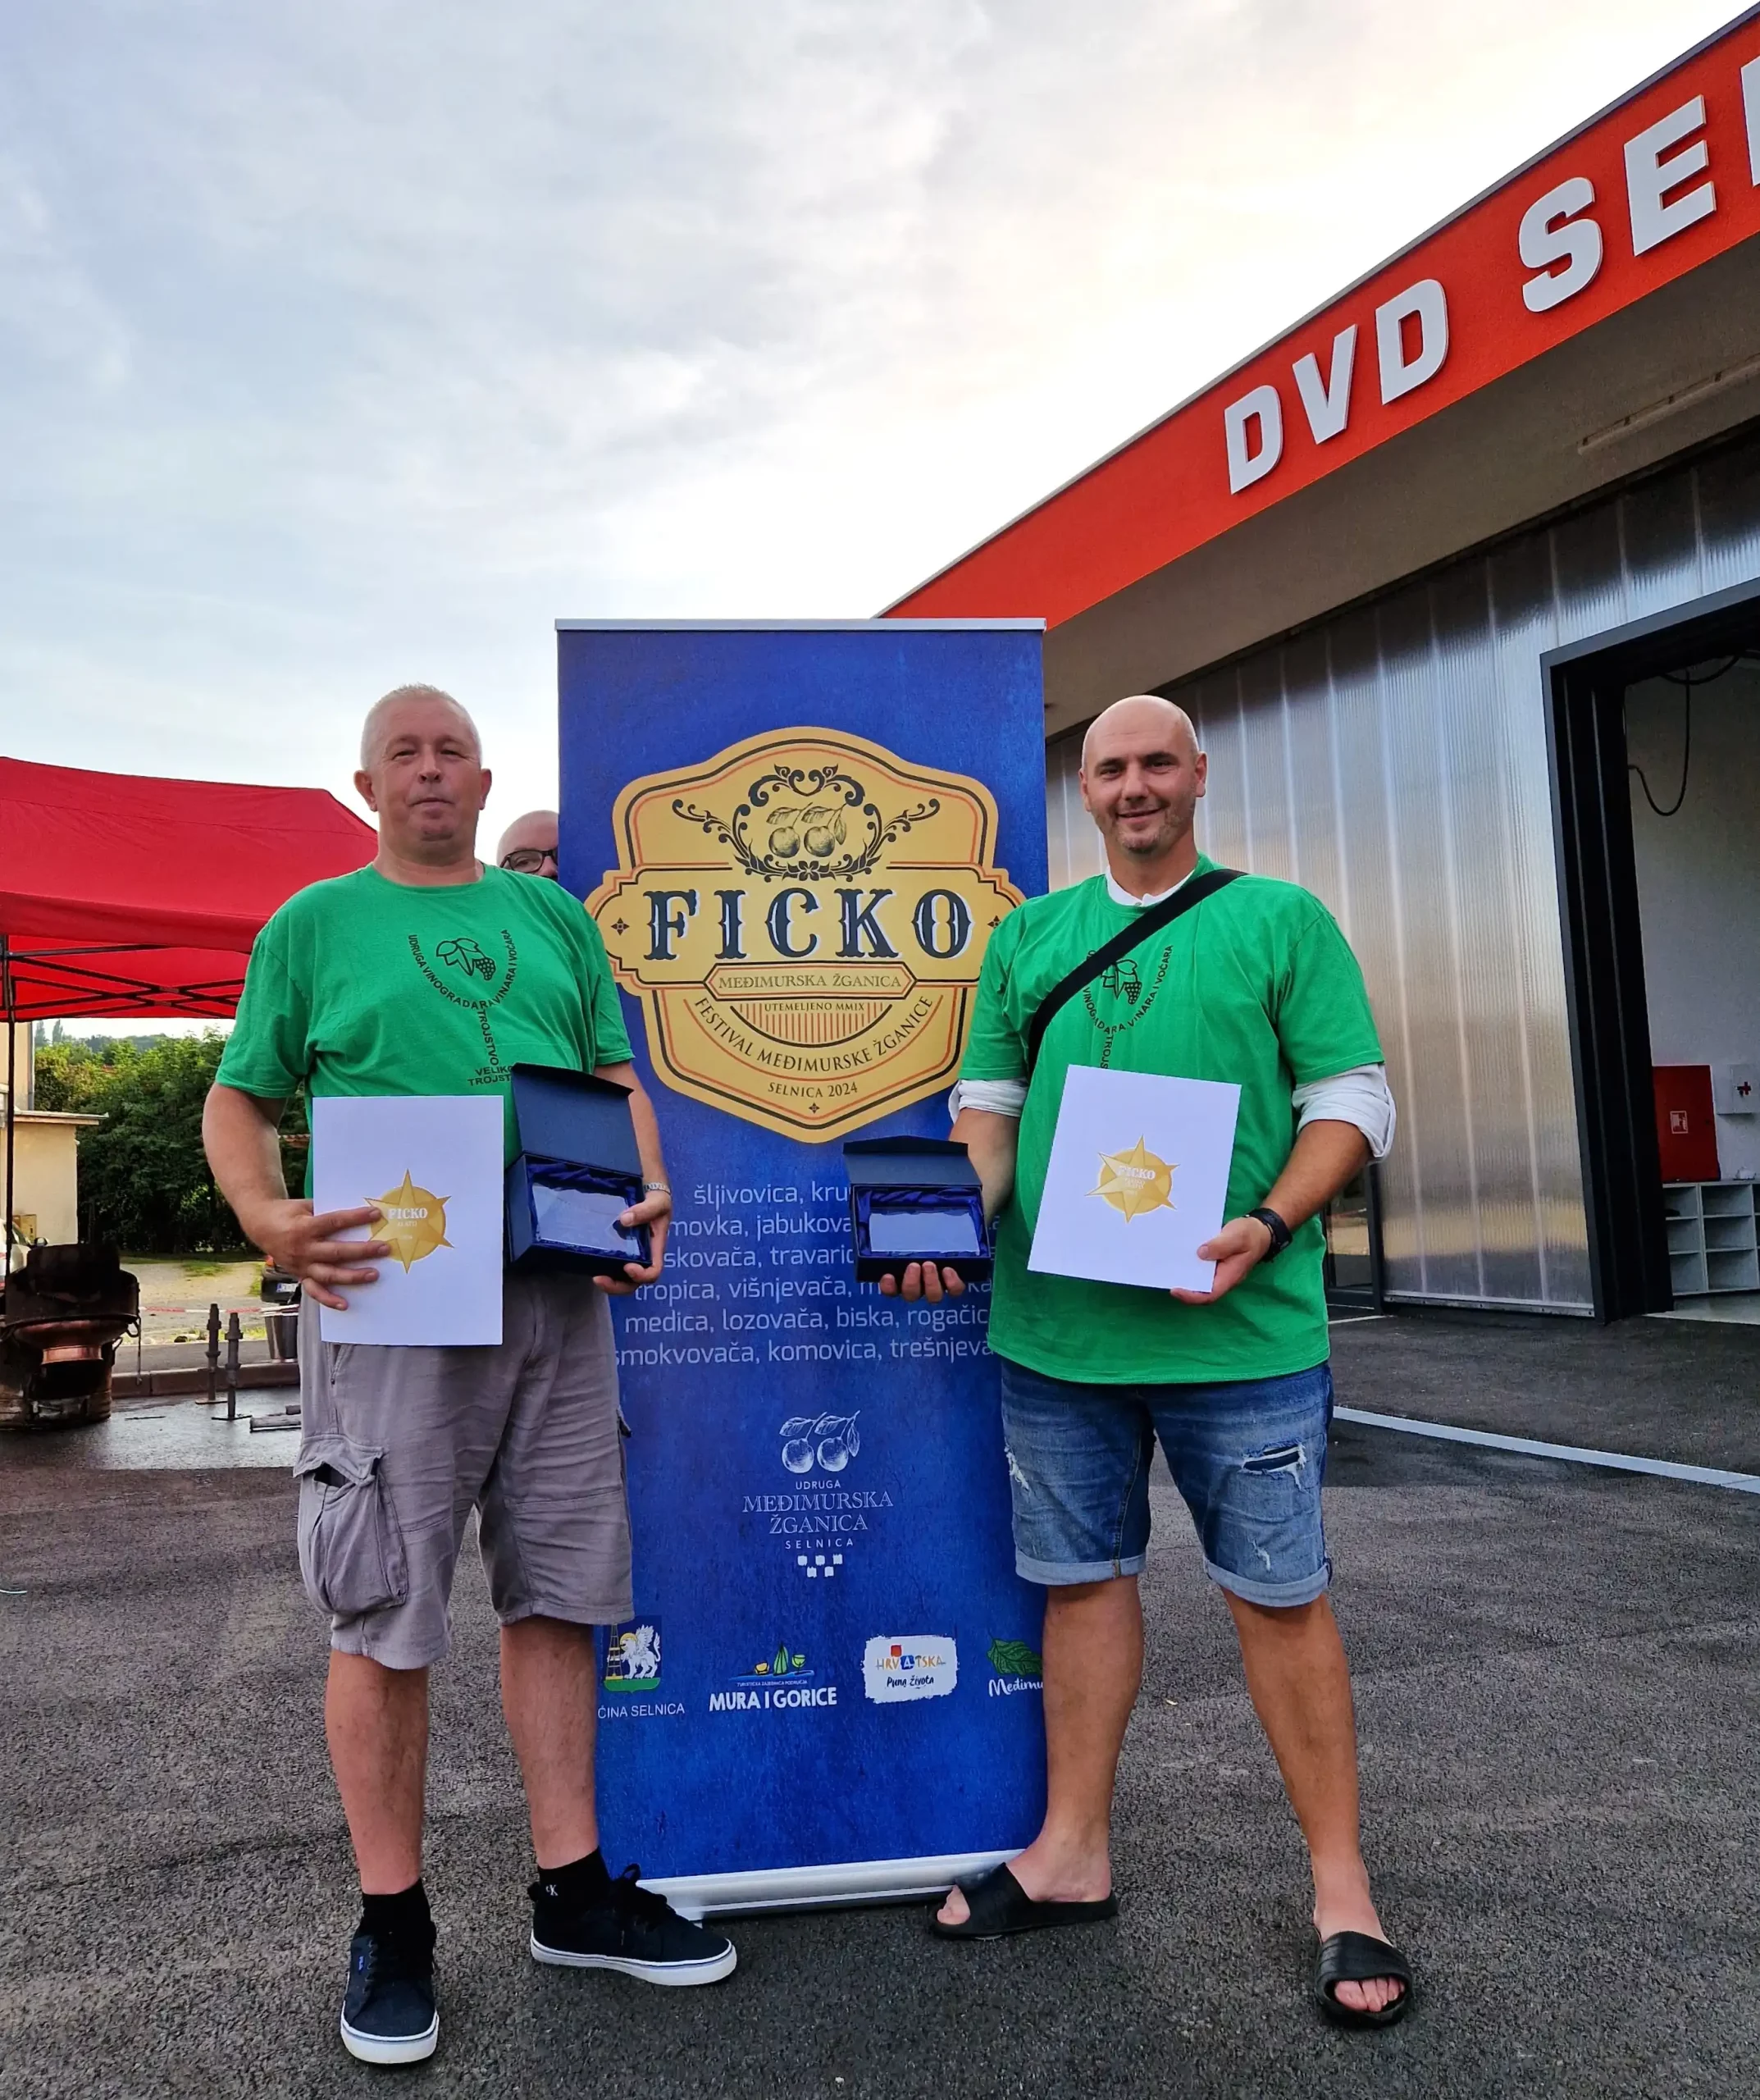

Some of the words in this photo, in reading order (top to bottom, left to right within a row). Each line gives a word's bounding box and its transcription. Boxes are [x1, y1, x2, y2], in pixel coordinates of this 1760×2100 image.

[1224, 278, 1449, 495] DVD
[643, 888, 974, 961] FICKO
[408, 934, 427, 969] UDRUGA
[422, 965, 495, 1011] VINOGRADARA
[492, 967, 518, 1006] VINARA
[718, 975, 827, 989] MEĐIMURSKA
[832, 973, 902, 988] ŽGANICA
[764, 1002, 832, 1012] UTEMELJENO
[835, 1002, 865, 1011] MMIX
[1128, 990, 1158, 1027] VINARA
[477, 1009, 499, 1066] TROJSTVO
[695, 997, 752, 1057] FESTIVAL
[757, 1047, 873, 1072] MEĐIMURSKE
[872, 995, 933, 1057] ŽGANICE
[768, 1081, 823, 1098] SELNICA
[828, 1080, 858, 1098] 2024
[694, 1183, 805, 1212] šljivovica,
[811, 1180, 851, 1202] kru
[663, 1245, 763, 1268] skovača,
[728, 1275, 852, 1304] višnjevača,
[625, 1309, 714, 1334] medica,
[723, 1307, 829, 1331] lozovača,
[837, 1305, 900, 1329] biska,
[907, 1303, 988, 1332] rogačic
[768, 1339, 882, 1361] komovica,
[796, 1479, 841, 1491] UDRUGA
[742, 1491, 894, 1513] MEĐIMURSKA
[768, 1513, 869, 1535] ŽGANICA
[785, 1538, 854, 1550] SELNICA
[875, 1654, 946, 1670] HRVATSKA
[631, 1703, 686, 1717] SELNICA
[709, 1691, 761, 1712] MURA
[764, 1691, 770, 1709] I
[773, 1687, 837, 1709] GORICE
